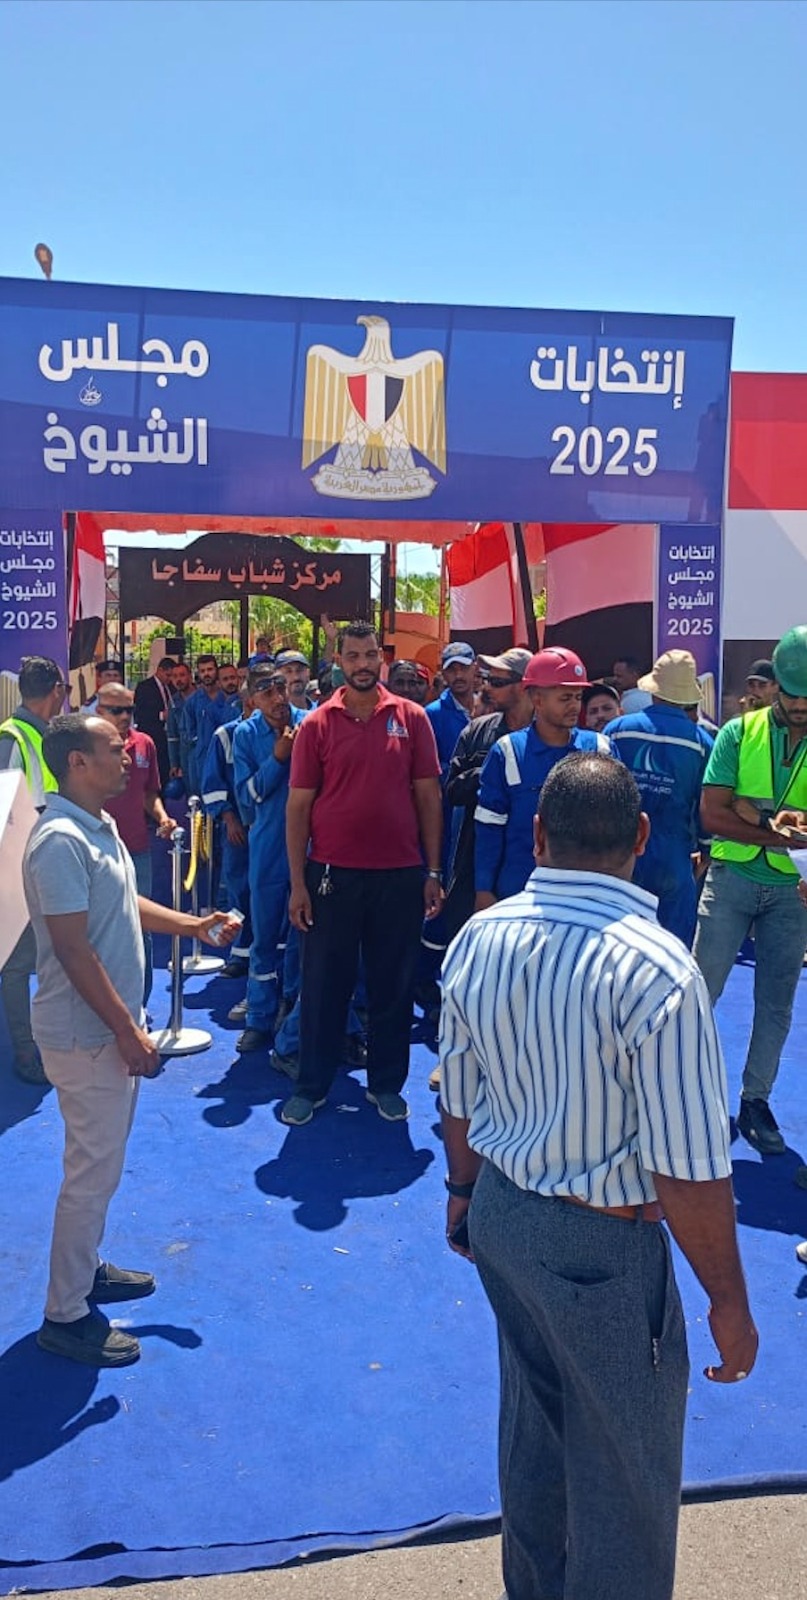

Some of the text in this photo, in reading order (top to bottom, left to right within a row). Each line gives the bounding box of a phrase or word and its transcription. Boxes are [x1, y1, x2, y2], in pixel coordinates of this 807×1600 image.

[39, 322, 209, 387] مجلس
[530, 345, 686, 409] إنتخابات
[43, 407, 208, 475] الشيوخ
[550, 425, 658, 477] 2025
[0, 530, 54, 550] إنتخابات
[0, 554, 55, 573] مجلس
[669, 545, 715, 564] إنتخابات
[151, 558, 343, 591] مركز شباب سفاجا
[668, 567, 715, 584] مجلس
[1, 579, 56, 602] الشيوخ
[668, 589, 714, 610] الشيوخ
[3, 611, 58, 630] 2025
[668, 618, 714, 636] 2025
